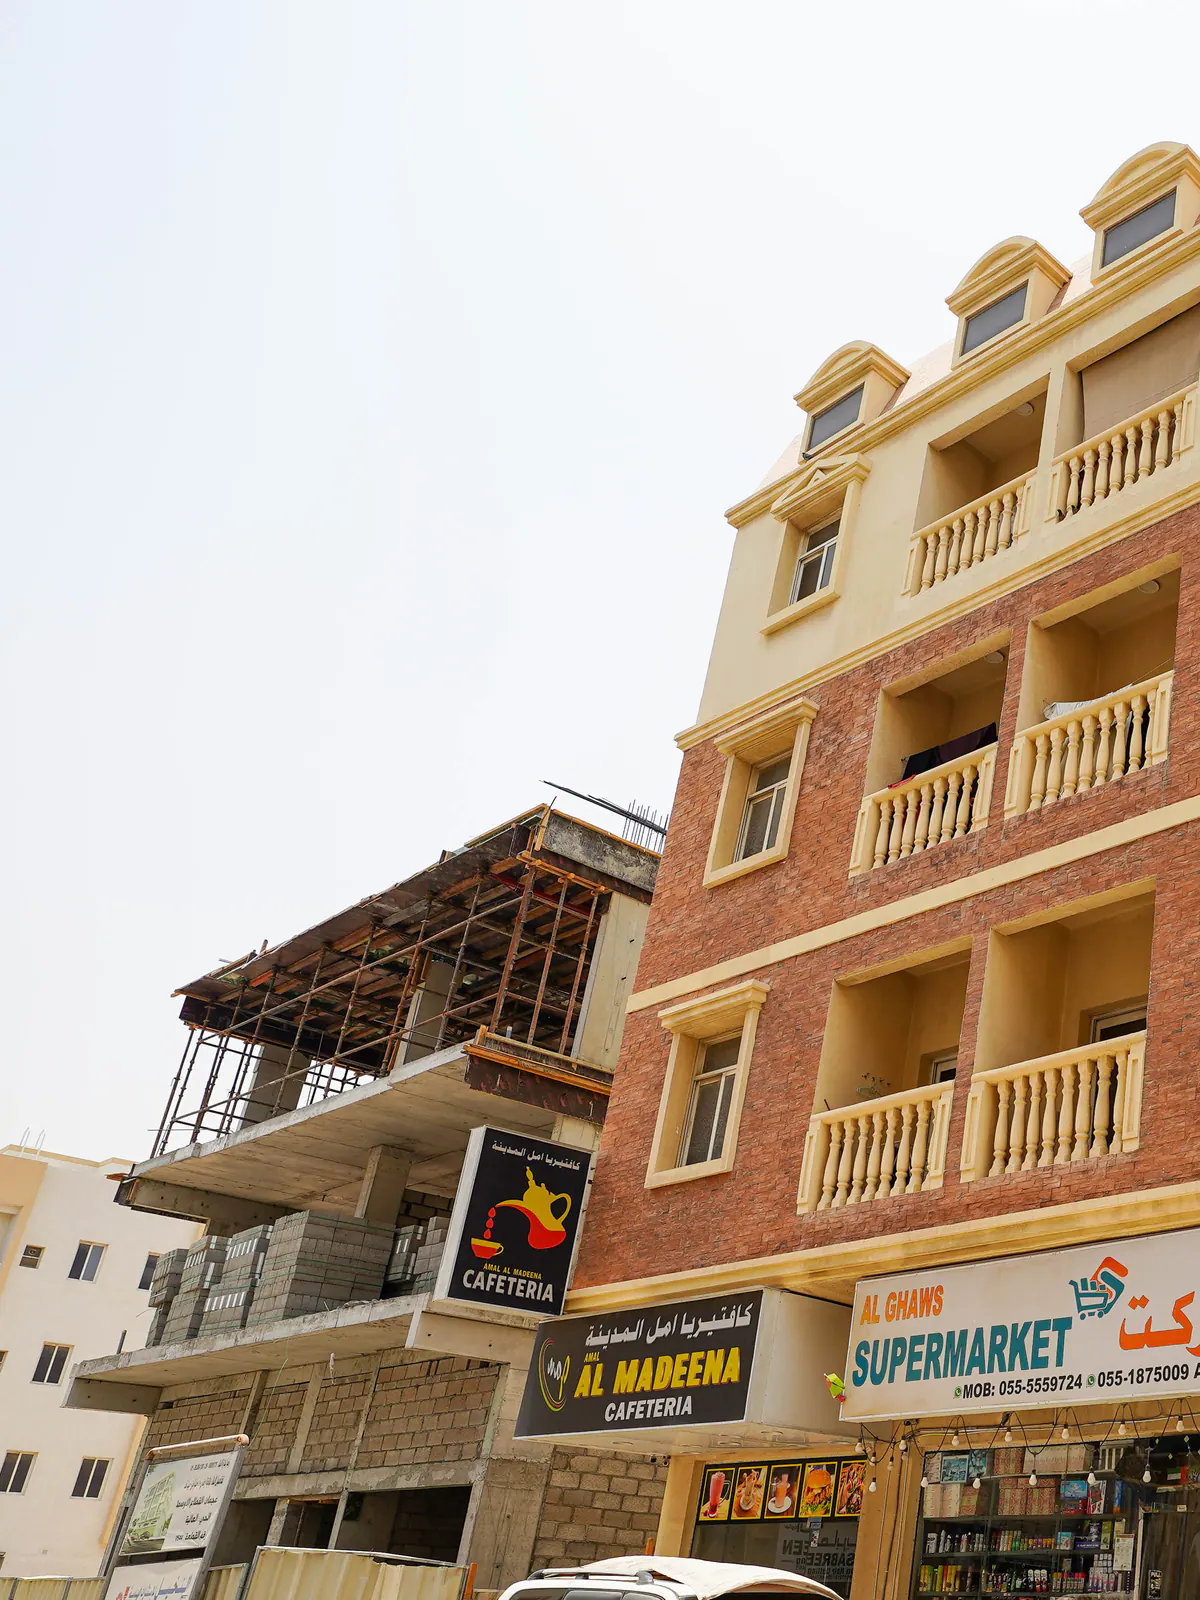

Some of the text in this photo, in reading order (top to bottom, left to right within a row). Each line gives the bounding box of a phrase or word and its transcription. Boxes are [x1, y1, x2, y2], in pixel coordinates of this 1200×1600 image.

[491, 1140, 527, 1157] المدينة
[462, 1269, 554, 1302] CAFETERIA
[483, 1262, 542, 1280] AMAL AL MADEENA
[860, 1284, 944, 1325] AL GHAWS
[585, 1302, 754, 1351] كافتيريا امل المدينة
[583, 1351, 600, 1364] AMAL
[851, 1316, 1073, 1388] SUPERMARKET
[573, 1362, 604, 1399] AL
[612, 1346, 741, 1395] MADEENA
[962, 1382, 996, 1399] MOB:
[999, 1374, 1083, 1396] 055-5559724
[1097, 1364, 1189, 1388] 055-1875009
[604, 1395, 693, 1422] CAFETERIA
